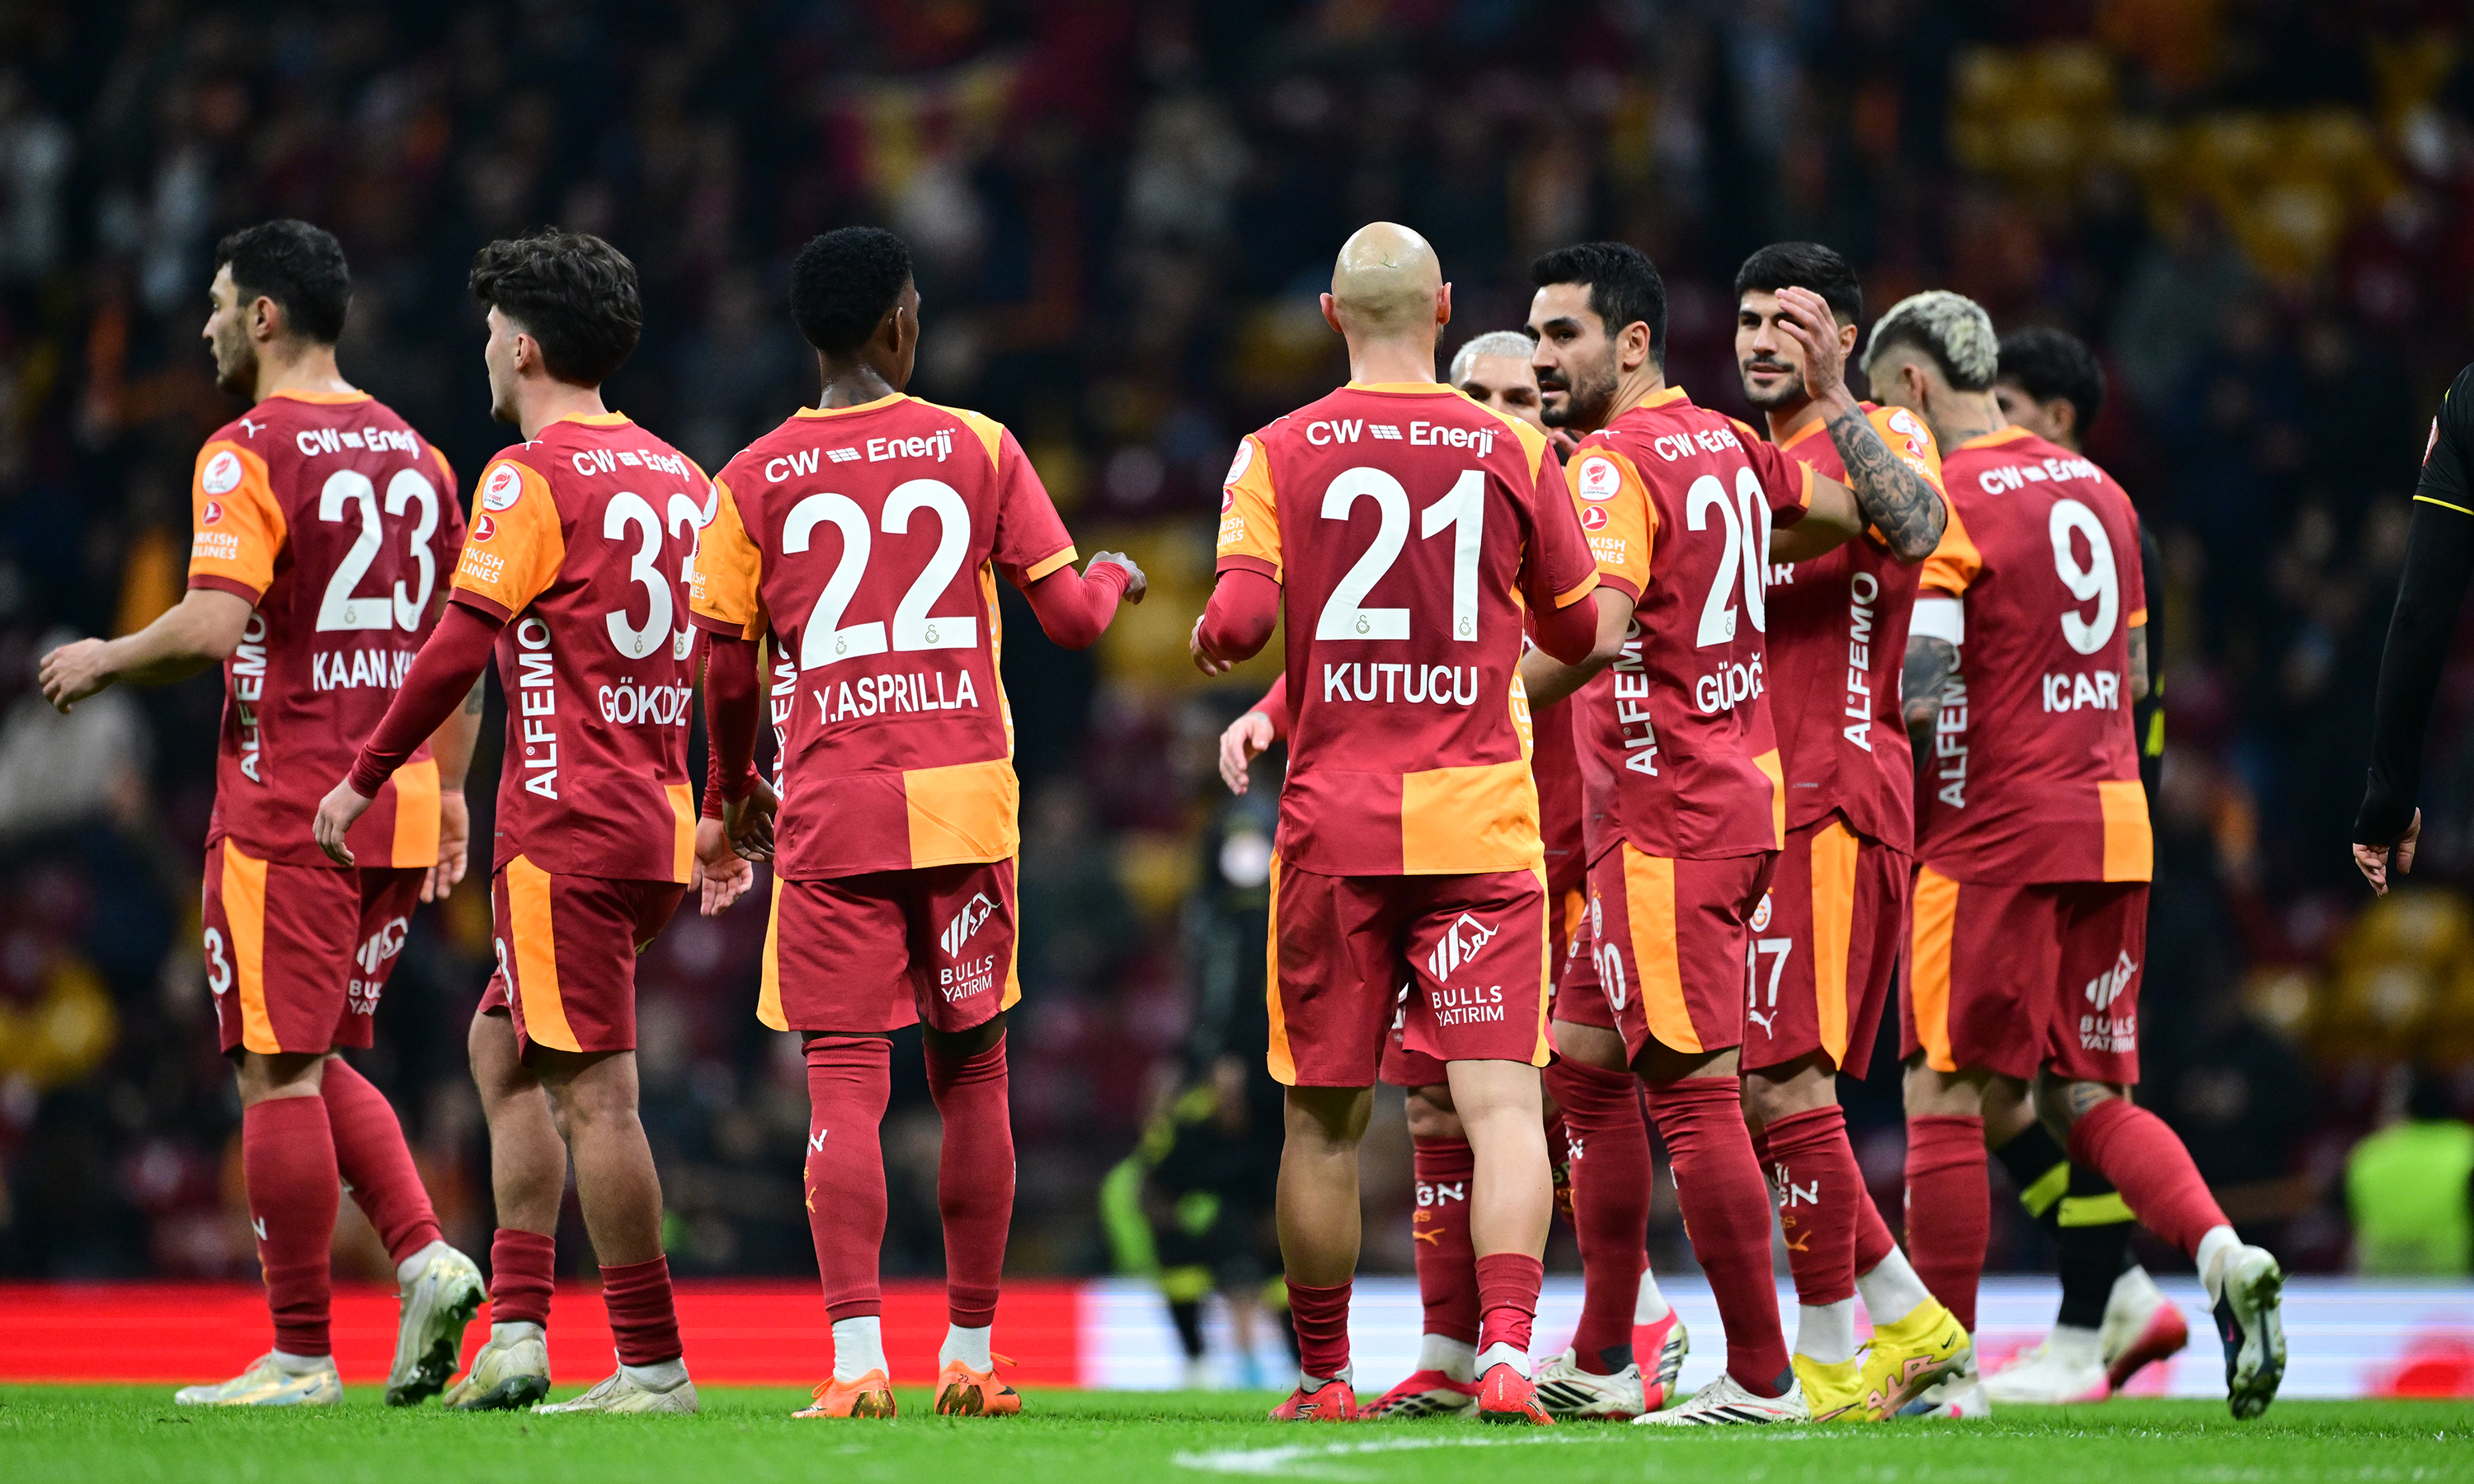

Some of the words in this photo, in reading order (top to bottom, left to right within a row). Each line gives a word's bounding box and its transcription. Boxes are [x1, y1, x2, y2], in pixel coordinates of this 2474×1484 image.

[296, 427, 341, 457] CW
[572, 448, 617, 477] CW
[765, 448, 820, 483] CW
[867, 430, 953, 463] Enerji
[1306, 419, 1363, 446] CW
[1410, 421, 1493, 458] Enerji
[1654, 433, 1697, 462] CW
[1979, 465, 2025, 495] CW
[315, 468, 440, 632] 23
[1315, 467, 1485, 641] 21
[1686, 467, 1772, 648] 20
[604, 491, 702, 661] 33
[783, 479, 977, 671] 22
[2049, 499, 2119, 655] 9
[313, 648, 388, 692] KAAN
[1324, 663, 1478, 706] KUTUCU
[1844, 571, 1879, 752] ALFEMO
[517, 618, 557, 801] ALFEMO
[813, 669, 979, 725] Y.ASPRILLA
[940, 955, 995, 985] BULLS
[941, 973, 992, 1003] YATIRIM
[1747, 937, 1792, 1007] 17
[1432, 985, 1503, 1009] BULLS
[1436, 1005, 1504, 1027] YATIRIM
